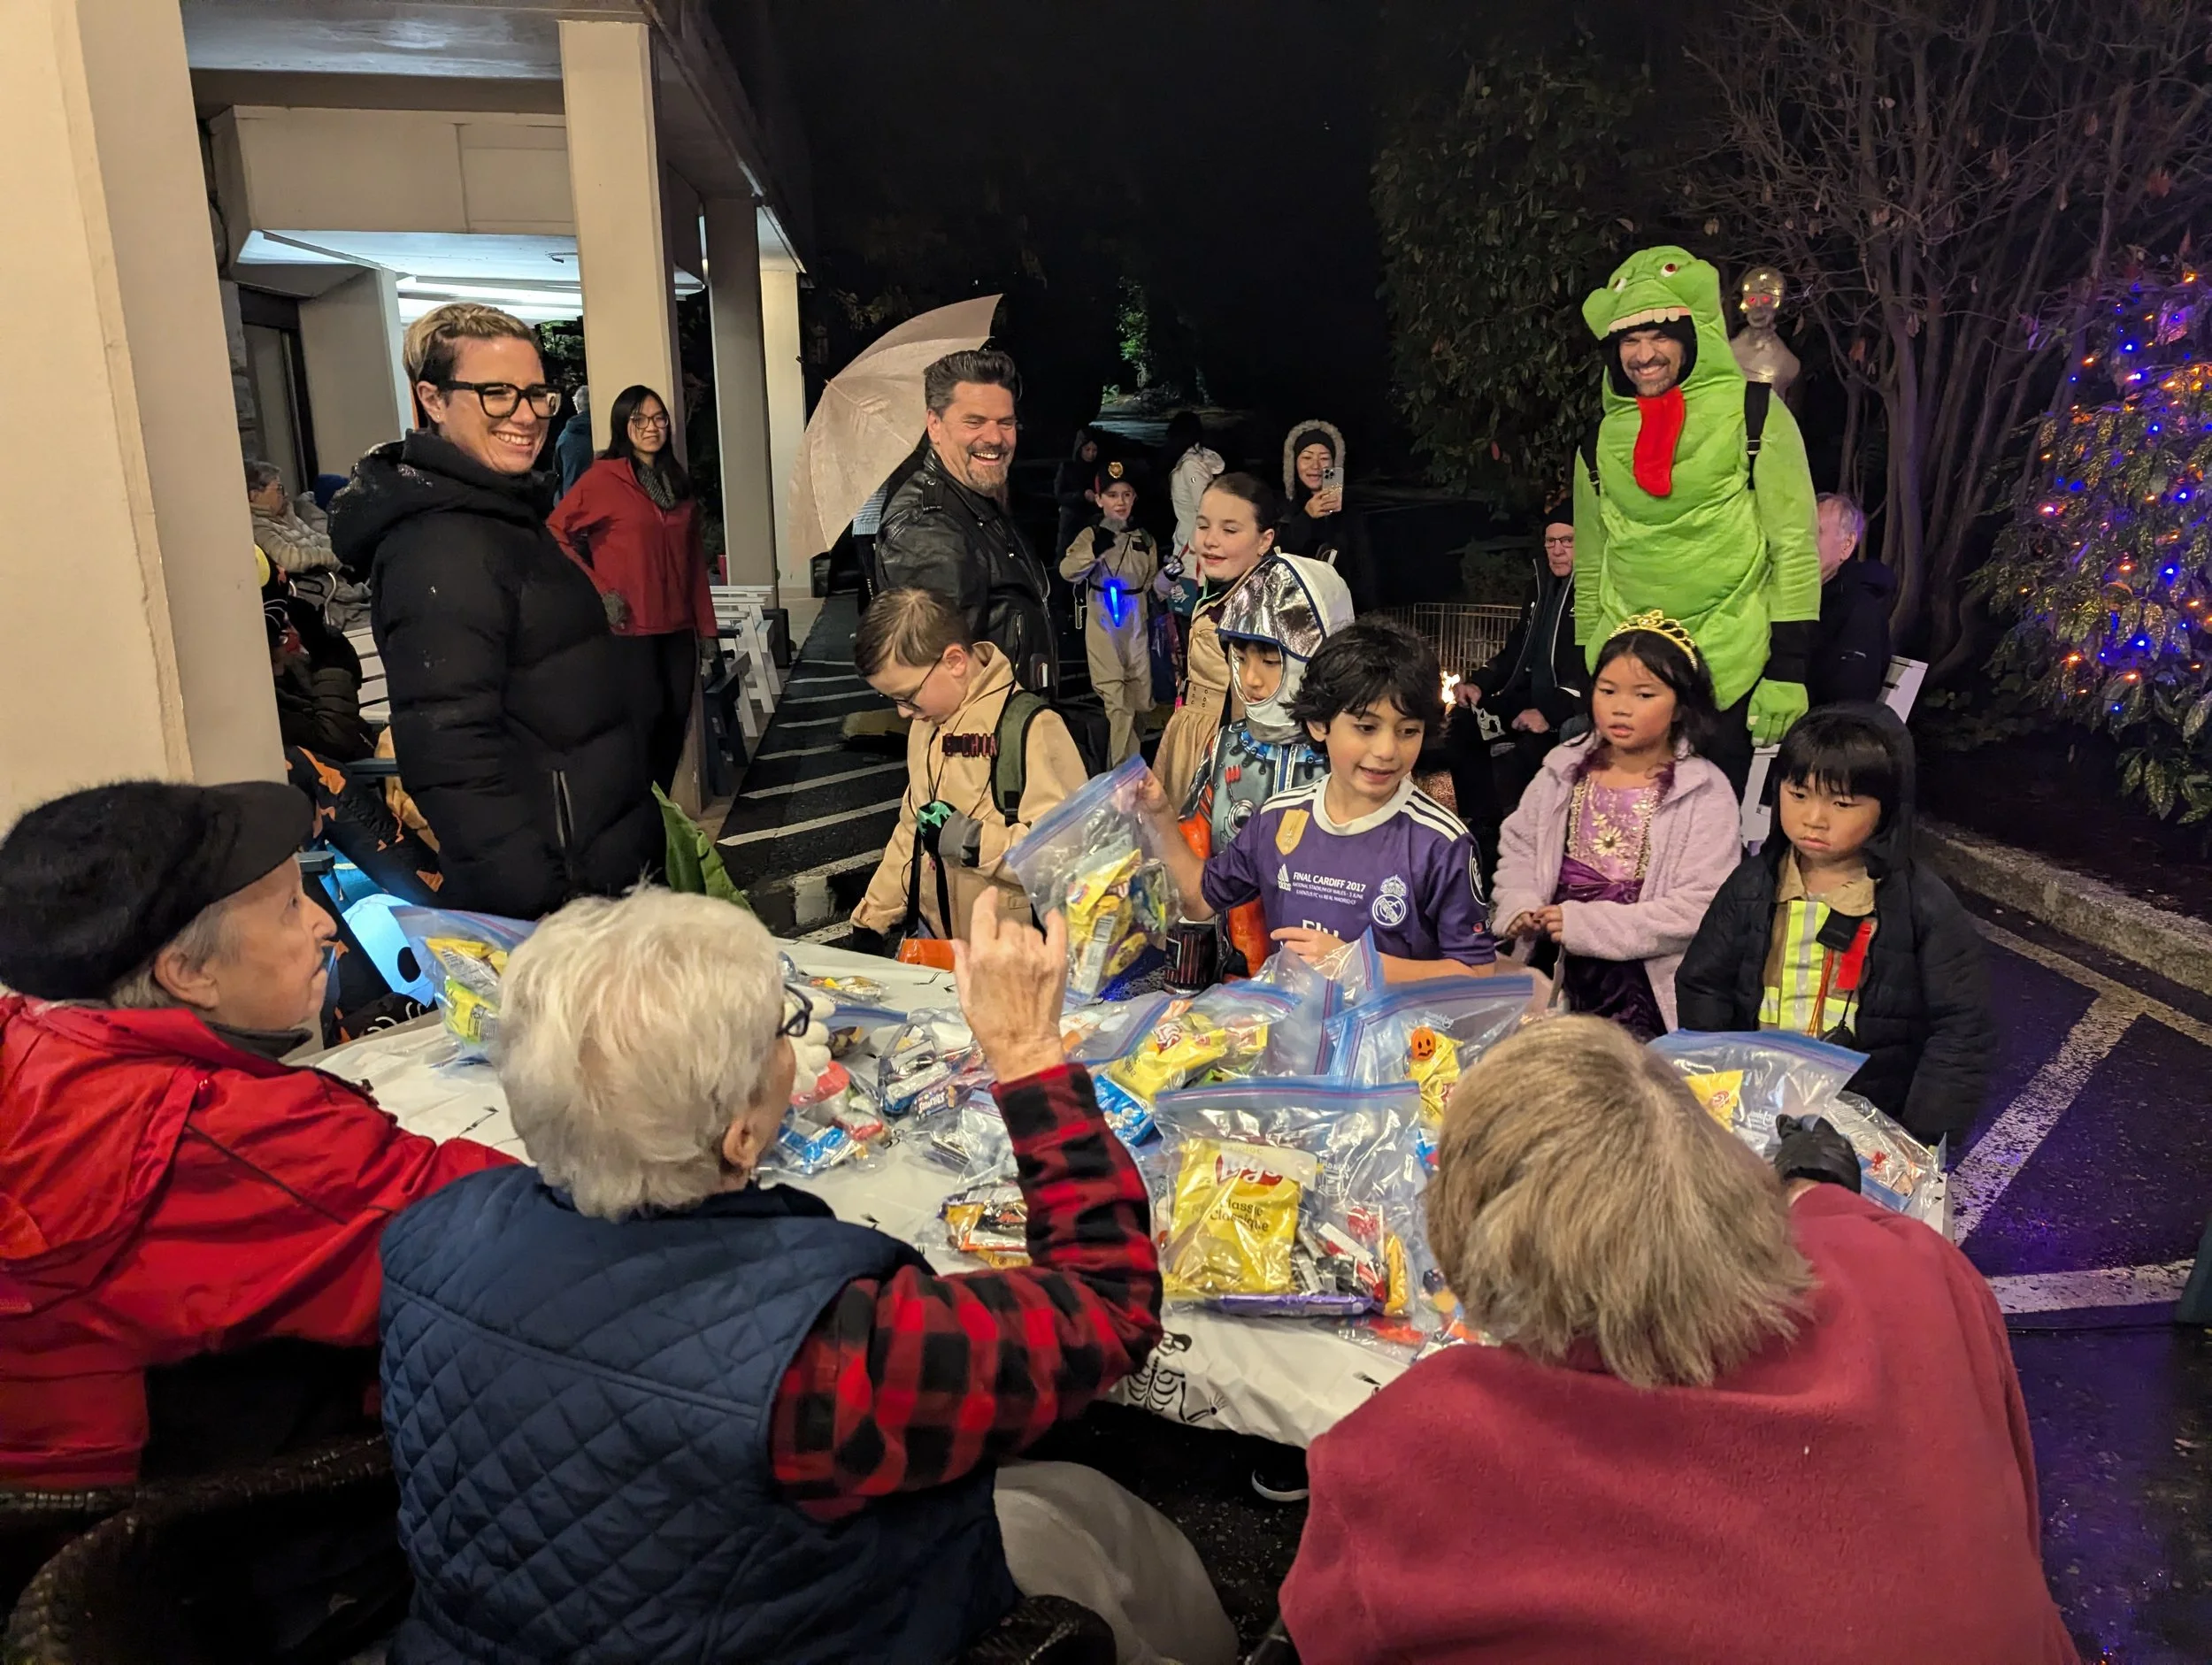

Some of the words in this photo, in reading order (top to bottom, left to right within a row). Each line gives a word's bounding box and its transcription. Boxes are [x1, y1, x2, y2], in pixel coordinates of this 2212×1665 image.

[1293, 871, 1312, 883] FINAL
[1313, 875, 1346, 888] CARDIFF
[1346, 880, 1366, 893] 2017
